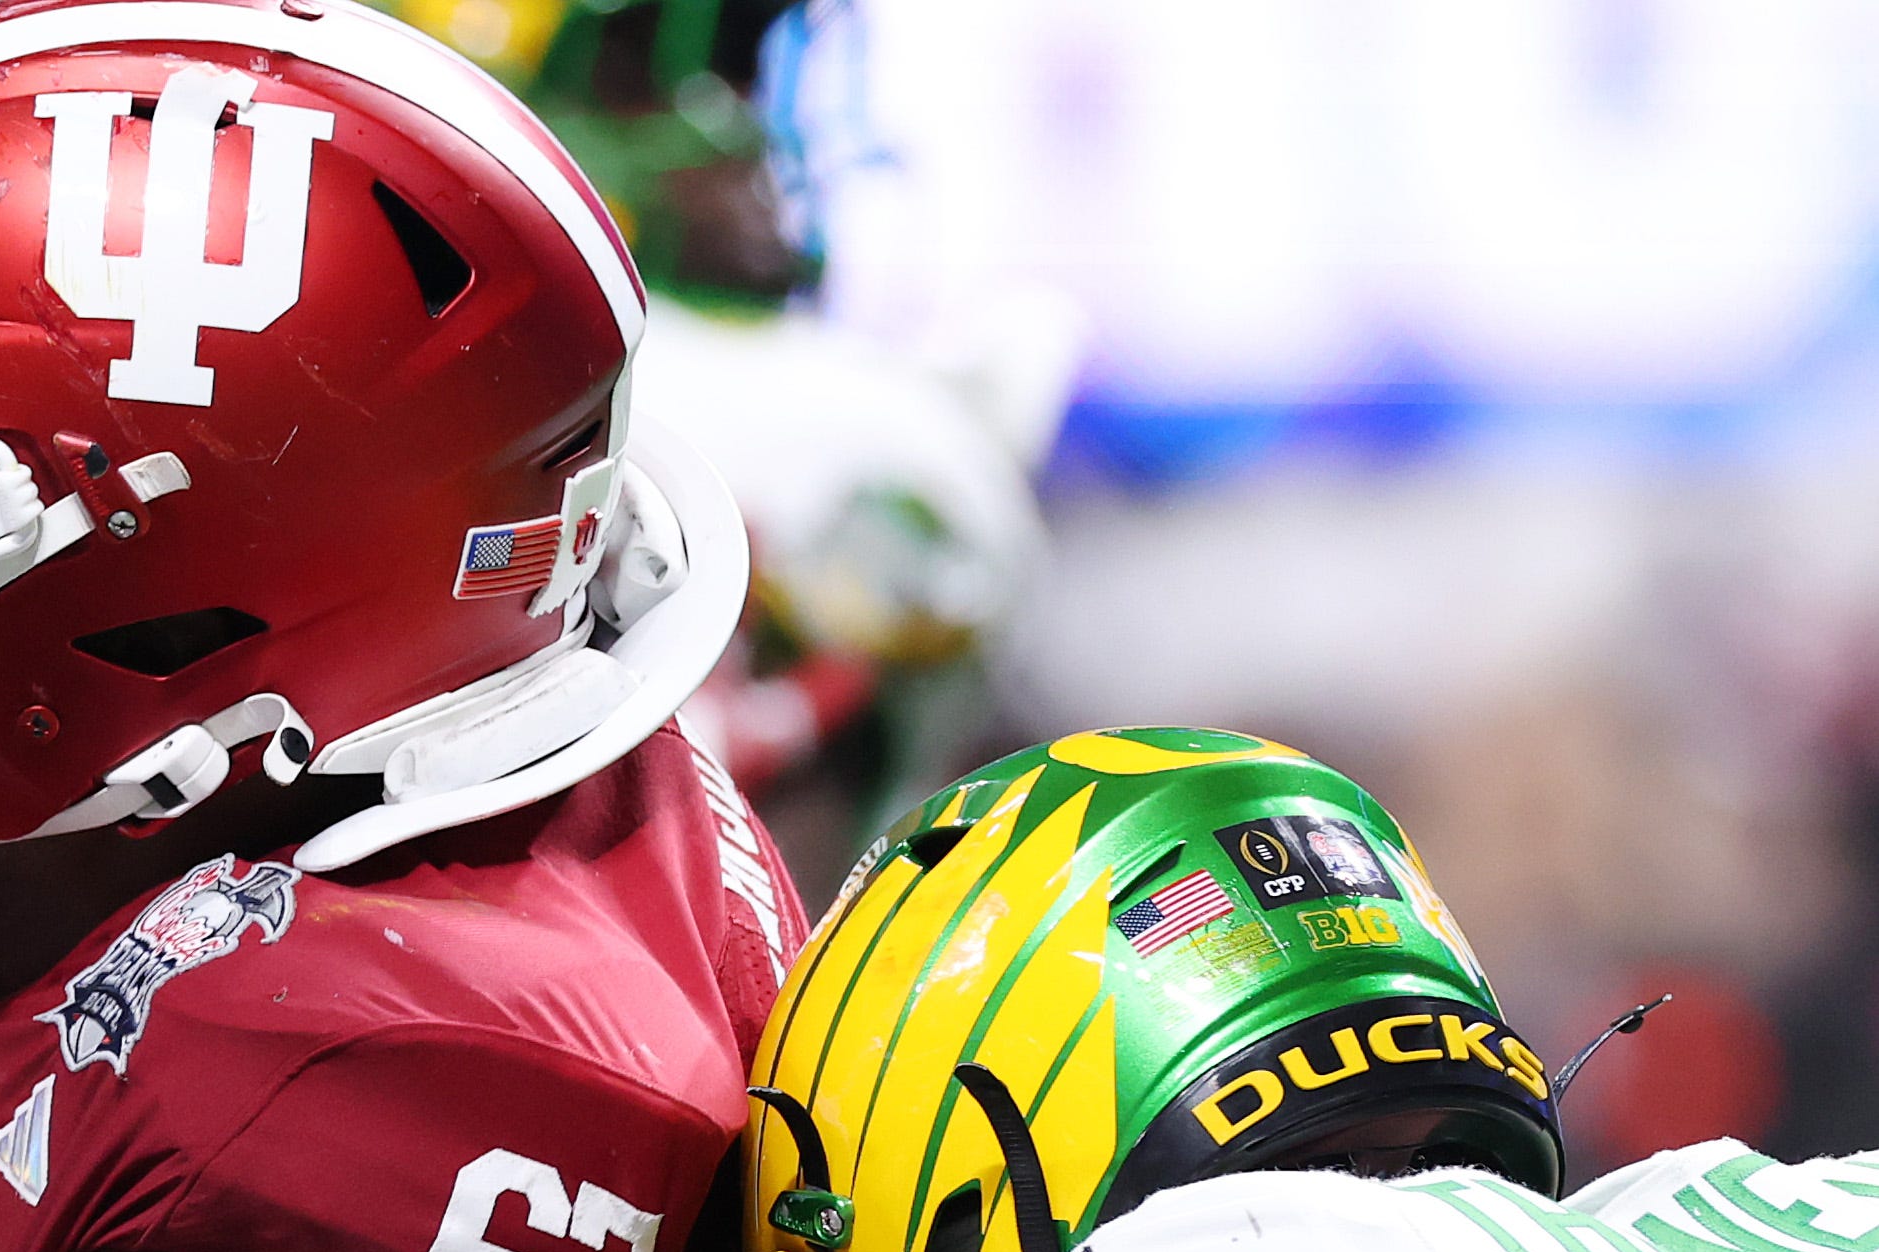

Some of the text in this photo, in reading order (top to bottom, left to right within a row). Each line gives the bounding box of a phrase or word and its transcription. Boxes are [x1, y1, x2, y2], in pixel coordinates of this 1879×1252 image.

[1263, 874, 1306, 897] CFP
[80, 990, 124, 1033] BOWL
[1191, 1013, 1549, 1147] DUCKS
